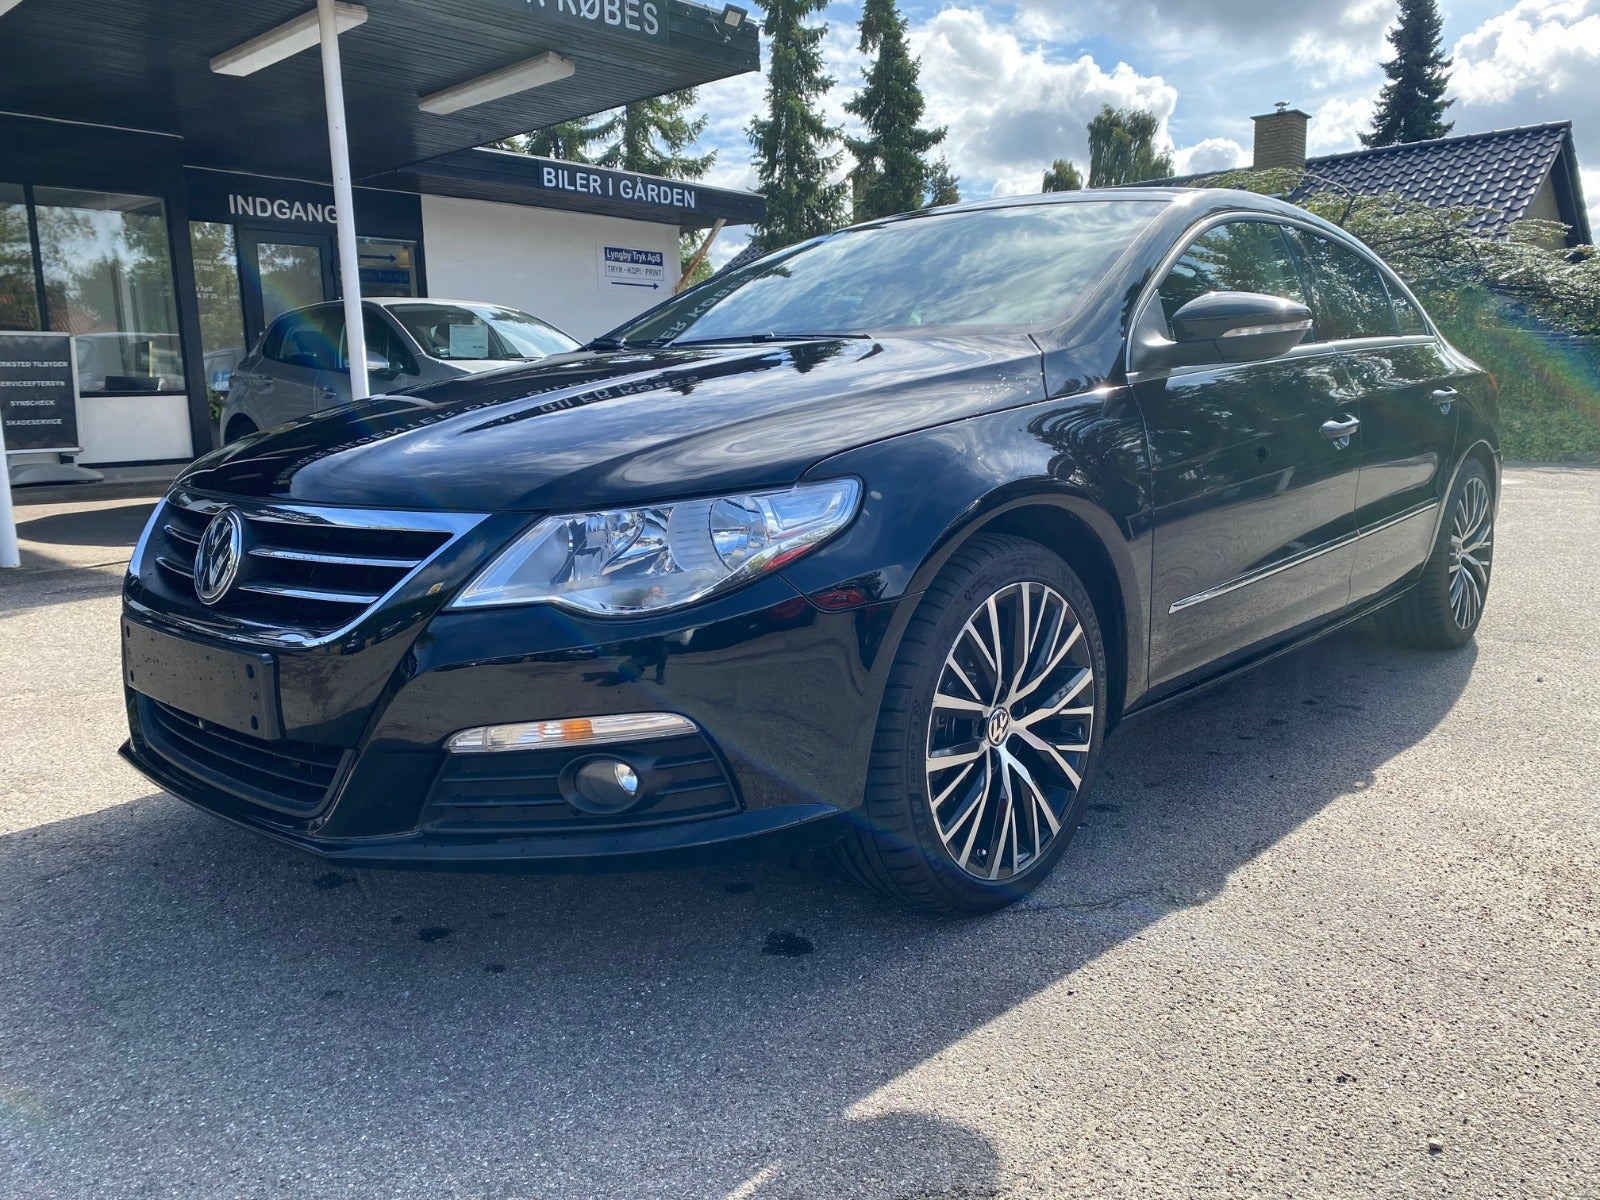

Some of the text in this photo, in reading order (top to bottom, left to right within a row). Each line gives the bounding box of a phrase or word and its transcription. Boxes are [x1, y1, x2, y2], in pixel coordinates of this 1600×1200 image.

[543, 166, 696, 209] BILER I GÅRDEN
[228, 193, 339, 224] INDGANG
[606, 248, 661, 264] Lyngby Tryk ApS
[607, 264, 623, 273] TRYK
[627, 266, 642, 275] KOPI
[645, 268, 662, 277] PRINT
[6, 418, 62, 426] SKADESERVICE
